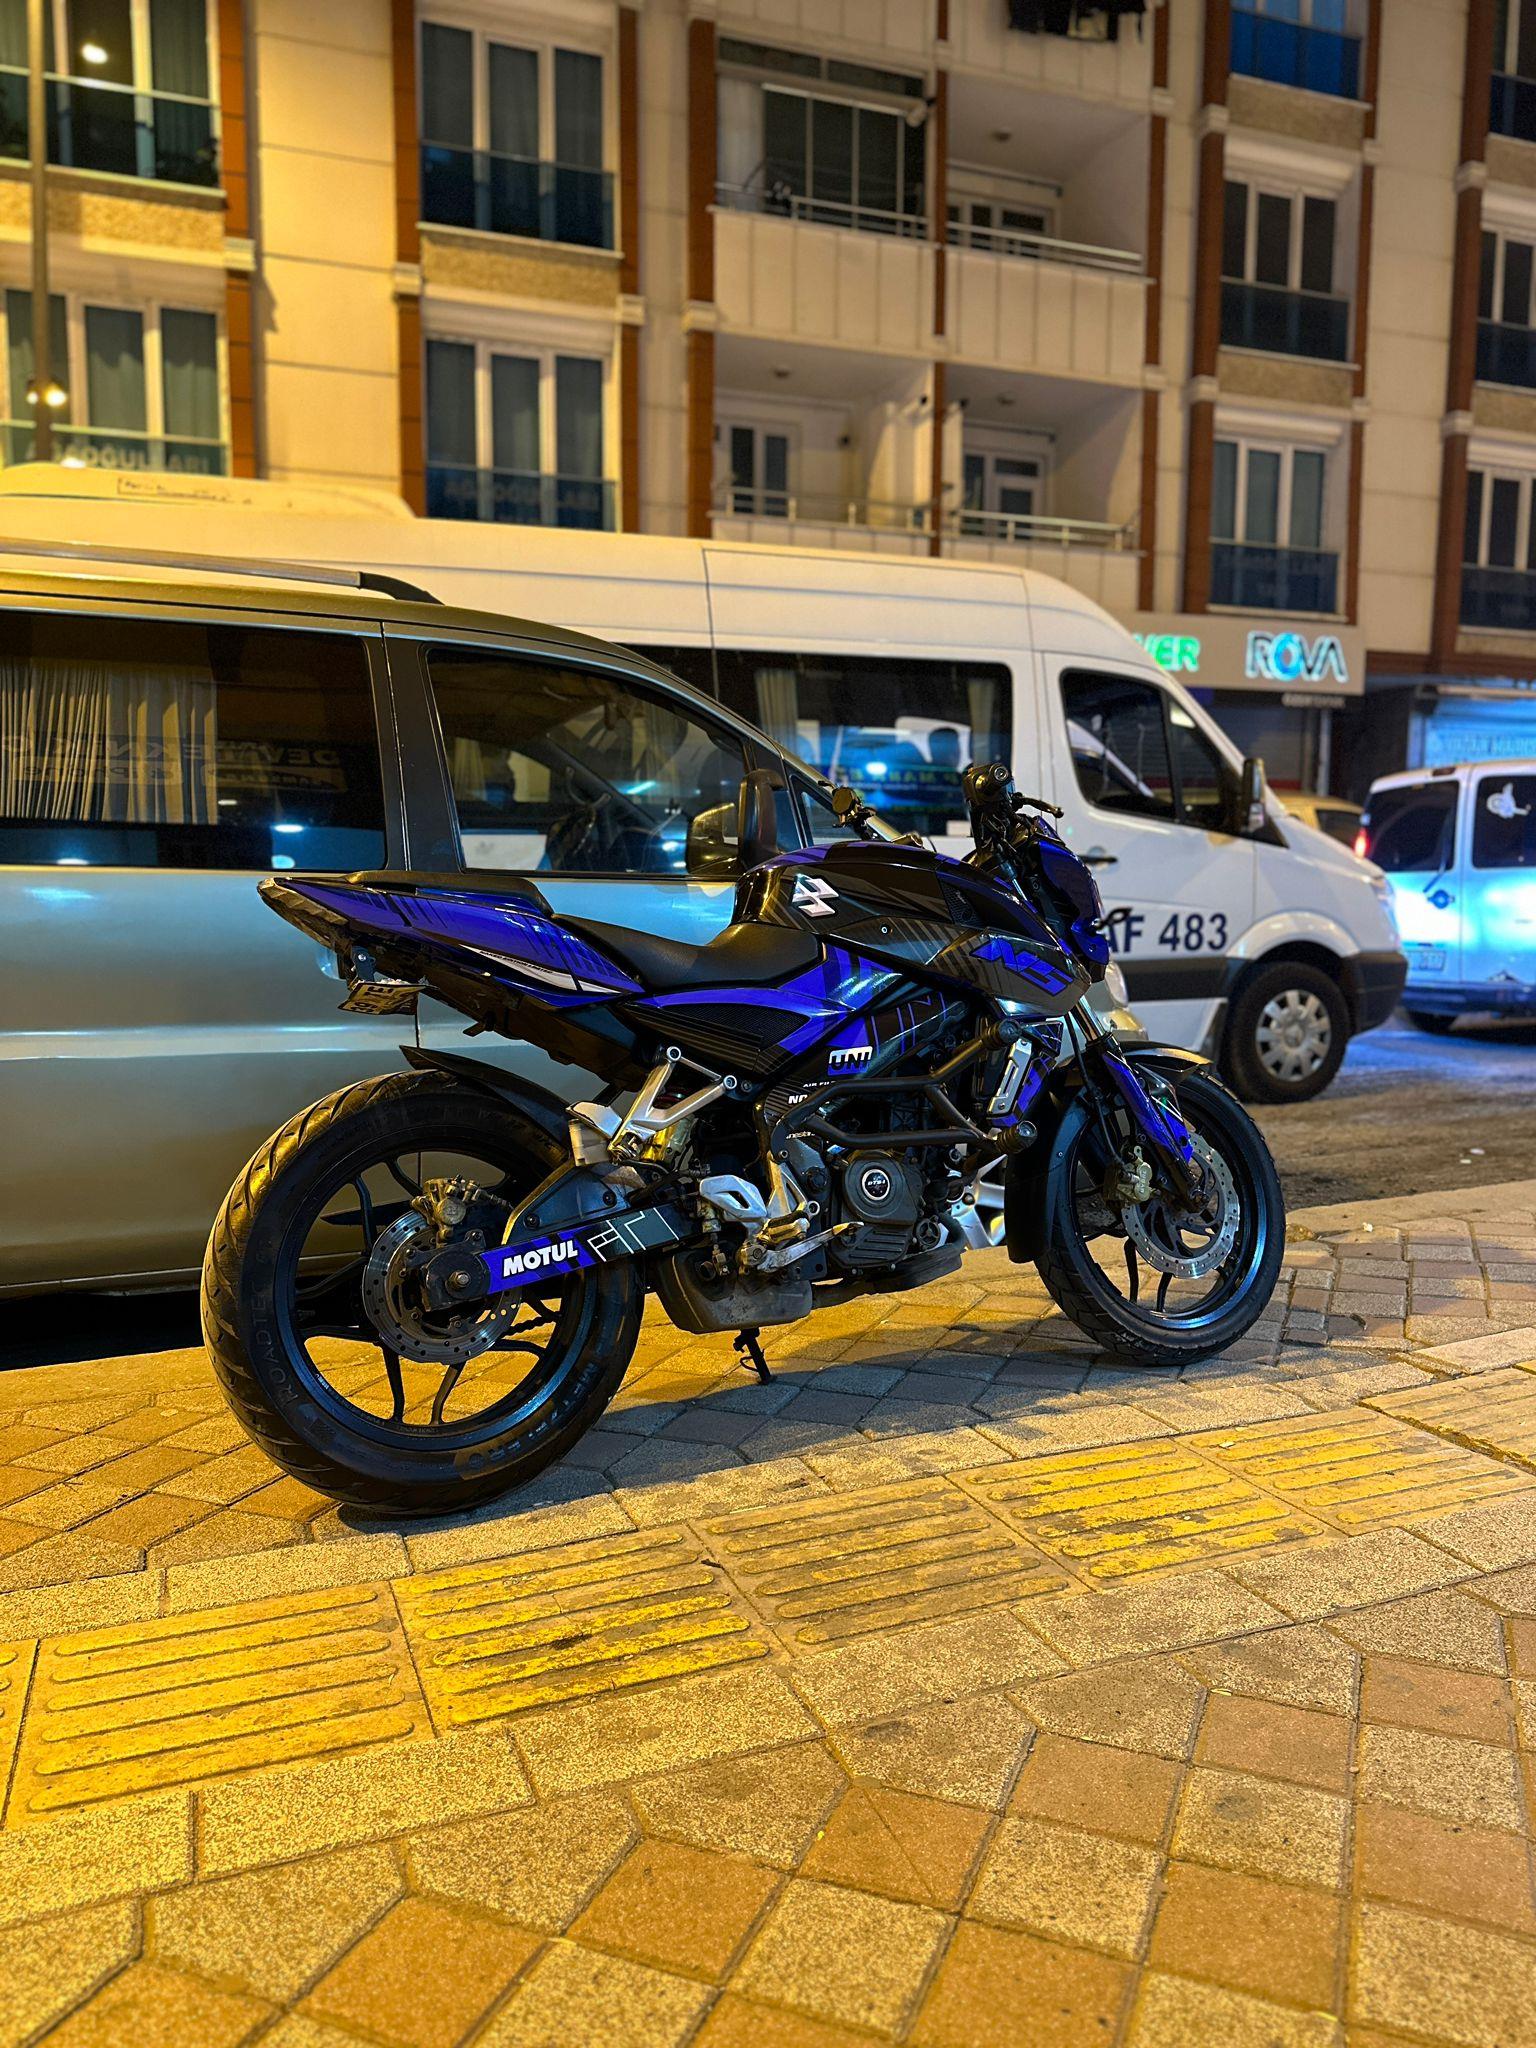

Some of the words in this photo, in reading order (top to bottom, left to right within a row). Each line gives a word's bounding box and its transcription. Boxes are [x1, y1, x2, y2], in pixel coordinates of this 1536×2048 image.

[1244, 630, 1348, 684] ROVA
[1158, 912, 1227, 951] 483
[502, 1239, 579, 1278] MOTUL
